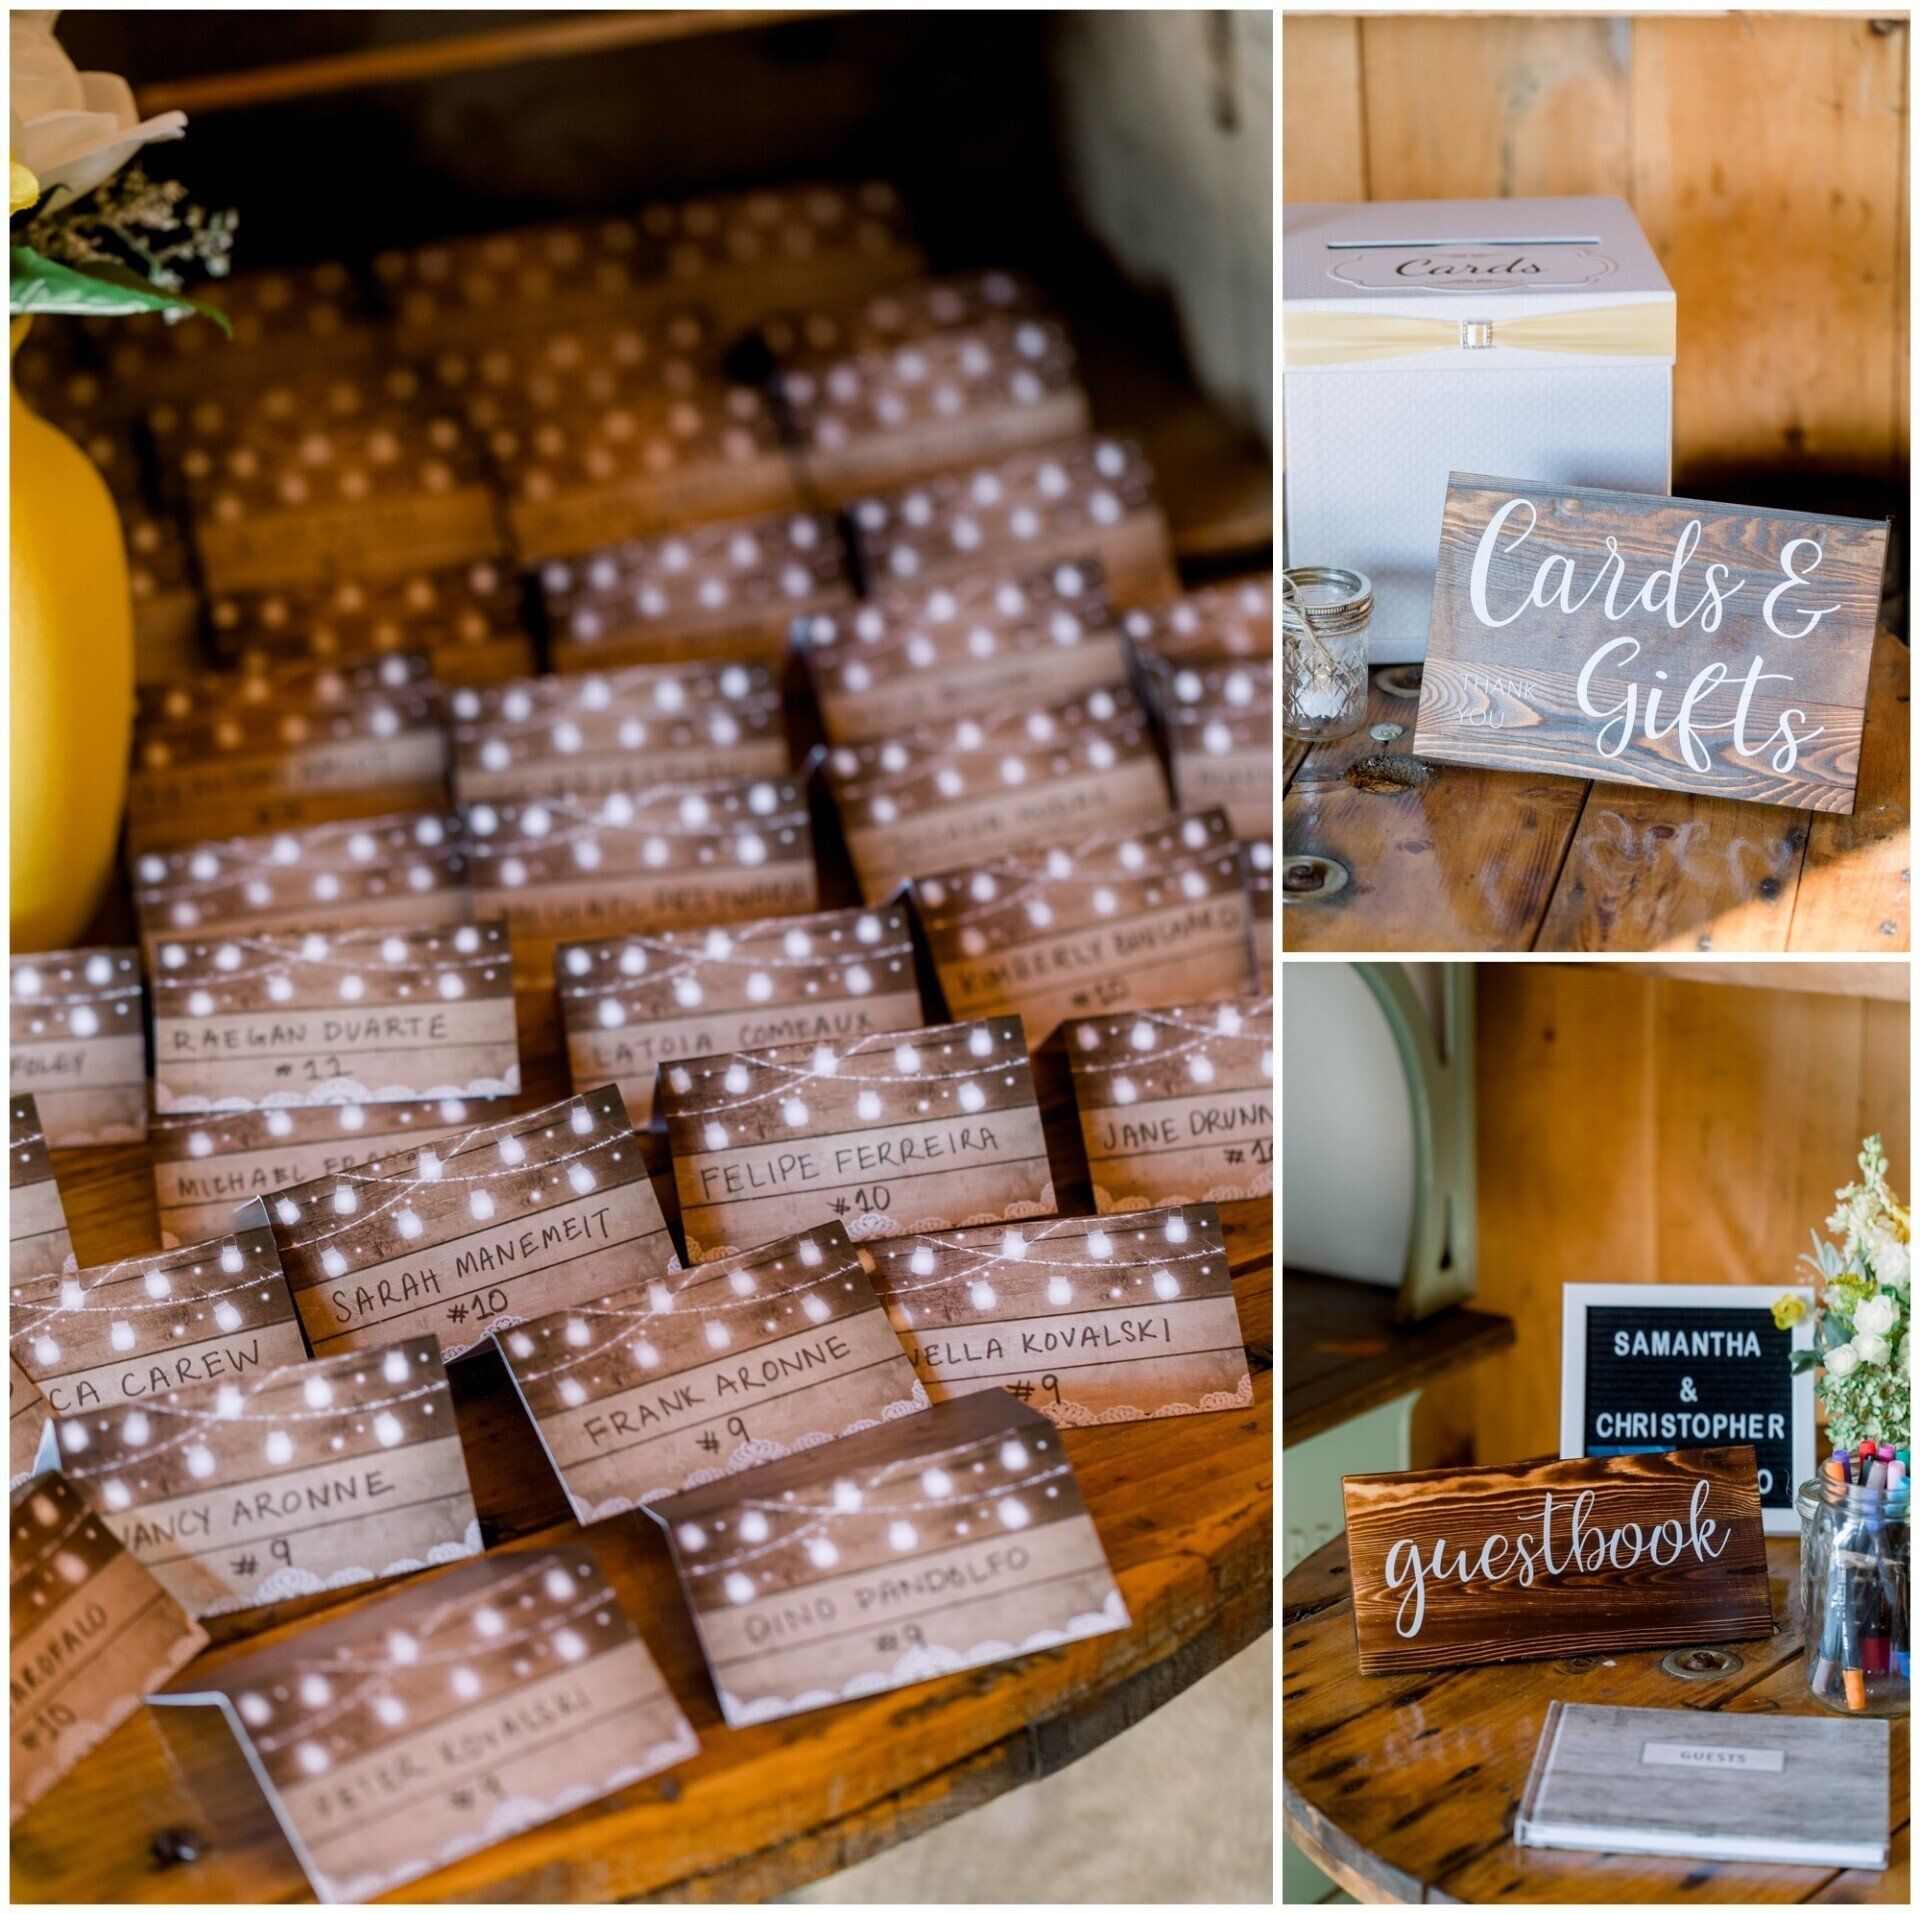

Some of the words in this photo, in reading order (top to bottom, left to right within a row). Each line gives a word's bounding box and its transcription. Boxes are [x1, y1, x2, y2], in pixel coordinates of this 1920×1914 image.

[1396, 256, 1548, 277] Cards
[1470, 498, 1745, 632] Cards
[1762, 537, 1841, 639] &
[1461, 673, 1537, 700] THANK
[1457, 705, 1505, 729] YOU
[1576, 636, 1824, 774] Gifts
[173, 1023, 307, 1051] RAEGAN
[325, 1014, 448, 1042] DUARTE
[739, 1011, 871, 1047] COMEAUX
[275, 1055, 354, 1081] #11
[1104, 1118, 1180, 1150] JANE
[700, 1153, 819, 1199] FELIPE
[835, 1127, 999, 1173] FERREIRA
[178, 1166, 307, 1197] MICHAEL
[827, 1185, 891, 1215] #10
[332, 1268, 441, 1323] SARAH
[456, 1207, 610, 1279] MANEMEIT
[447, 1287, 509, 1324] #10
[1022, 1318, 1171, 1354] KOVALSKI
[1613, 1330, 1762, 1358] SAMANTHA
[121, 1339, 260, 1397] CAREW
[583, 1386, 706, 1444] FRANK
[716, 1335, 851, 1397] ARONNE
[1007, 1374, 1061, 1405] #9
[1679, 1375, 1699, 1403] &
[696, 1416, 751, 1454] #9
[1595, 1412, 1786, 1440] CHRISTOPHER
[232, 1471, 396, 1526] ARONNE
[230, 1538, 292, 1576] #9
[1385, 1479, 1732, 1639] guestbook
[744, 1597, 838, 1644] DINO
[854, 1546, 1030, 1609] PANDOLFO
[1681, 1750, 1747, 1763] GUESTS
